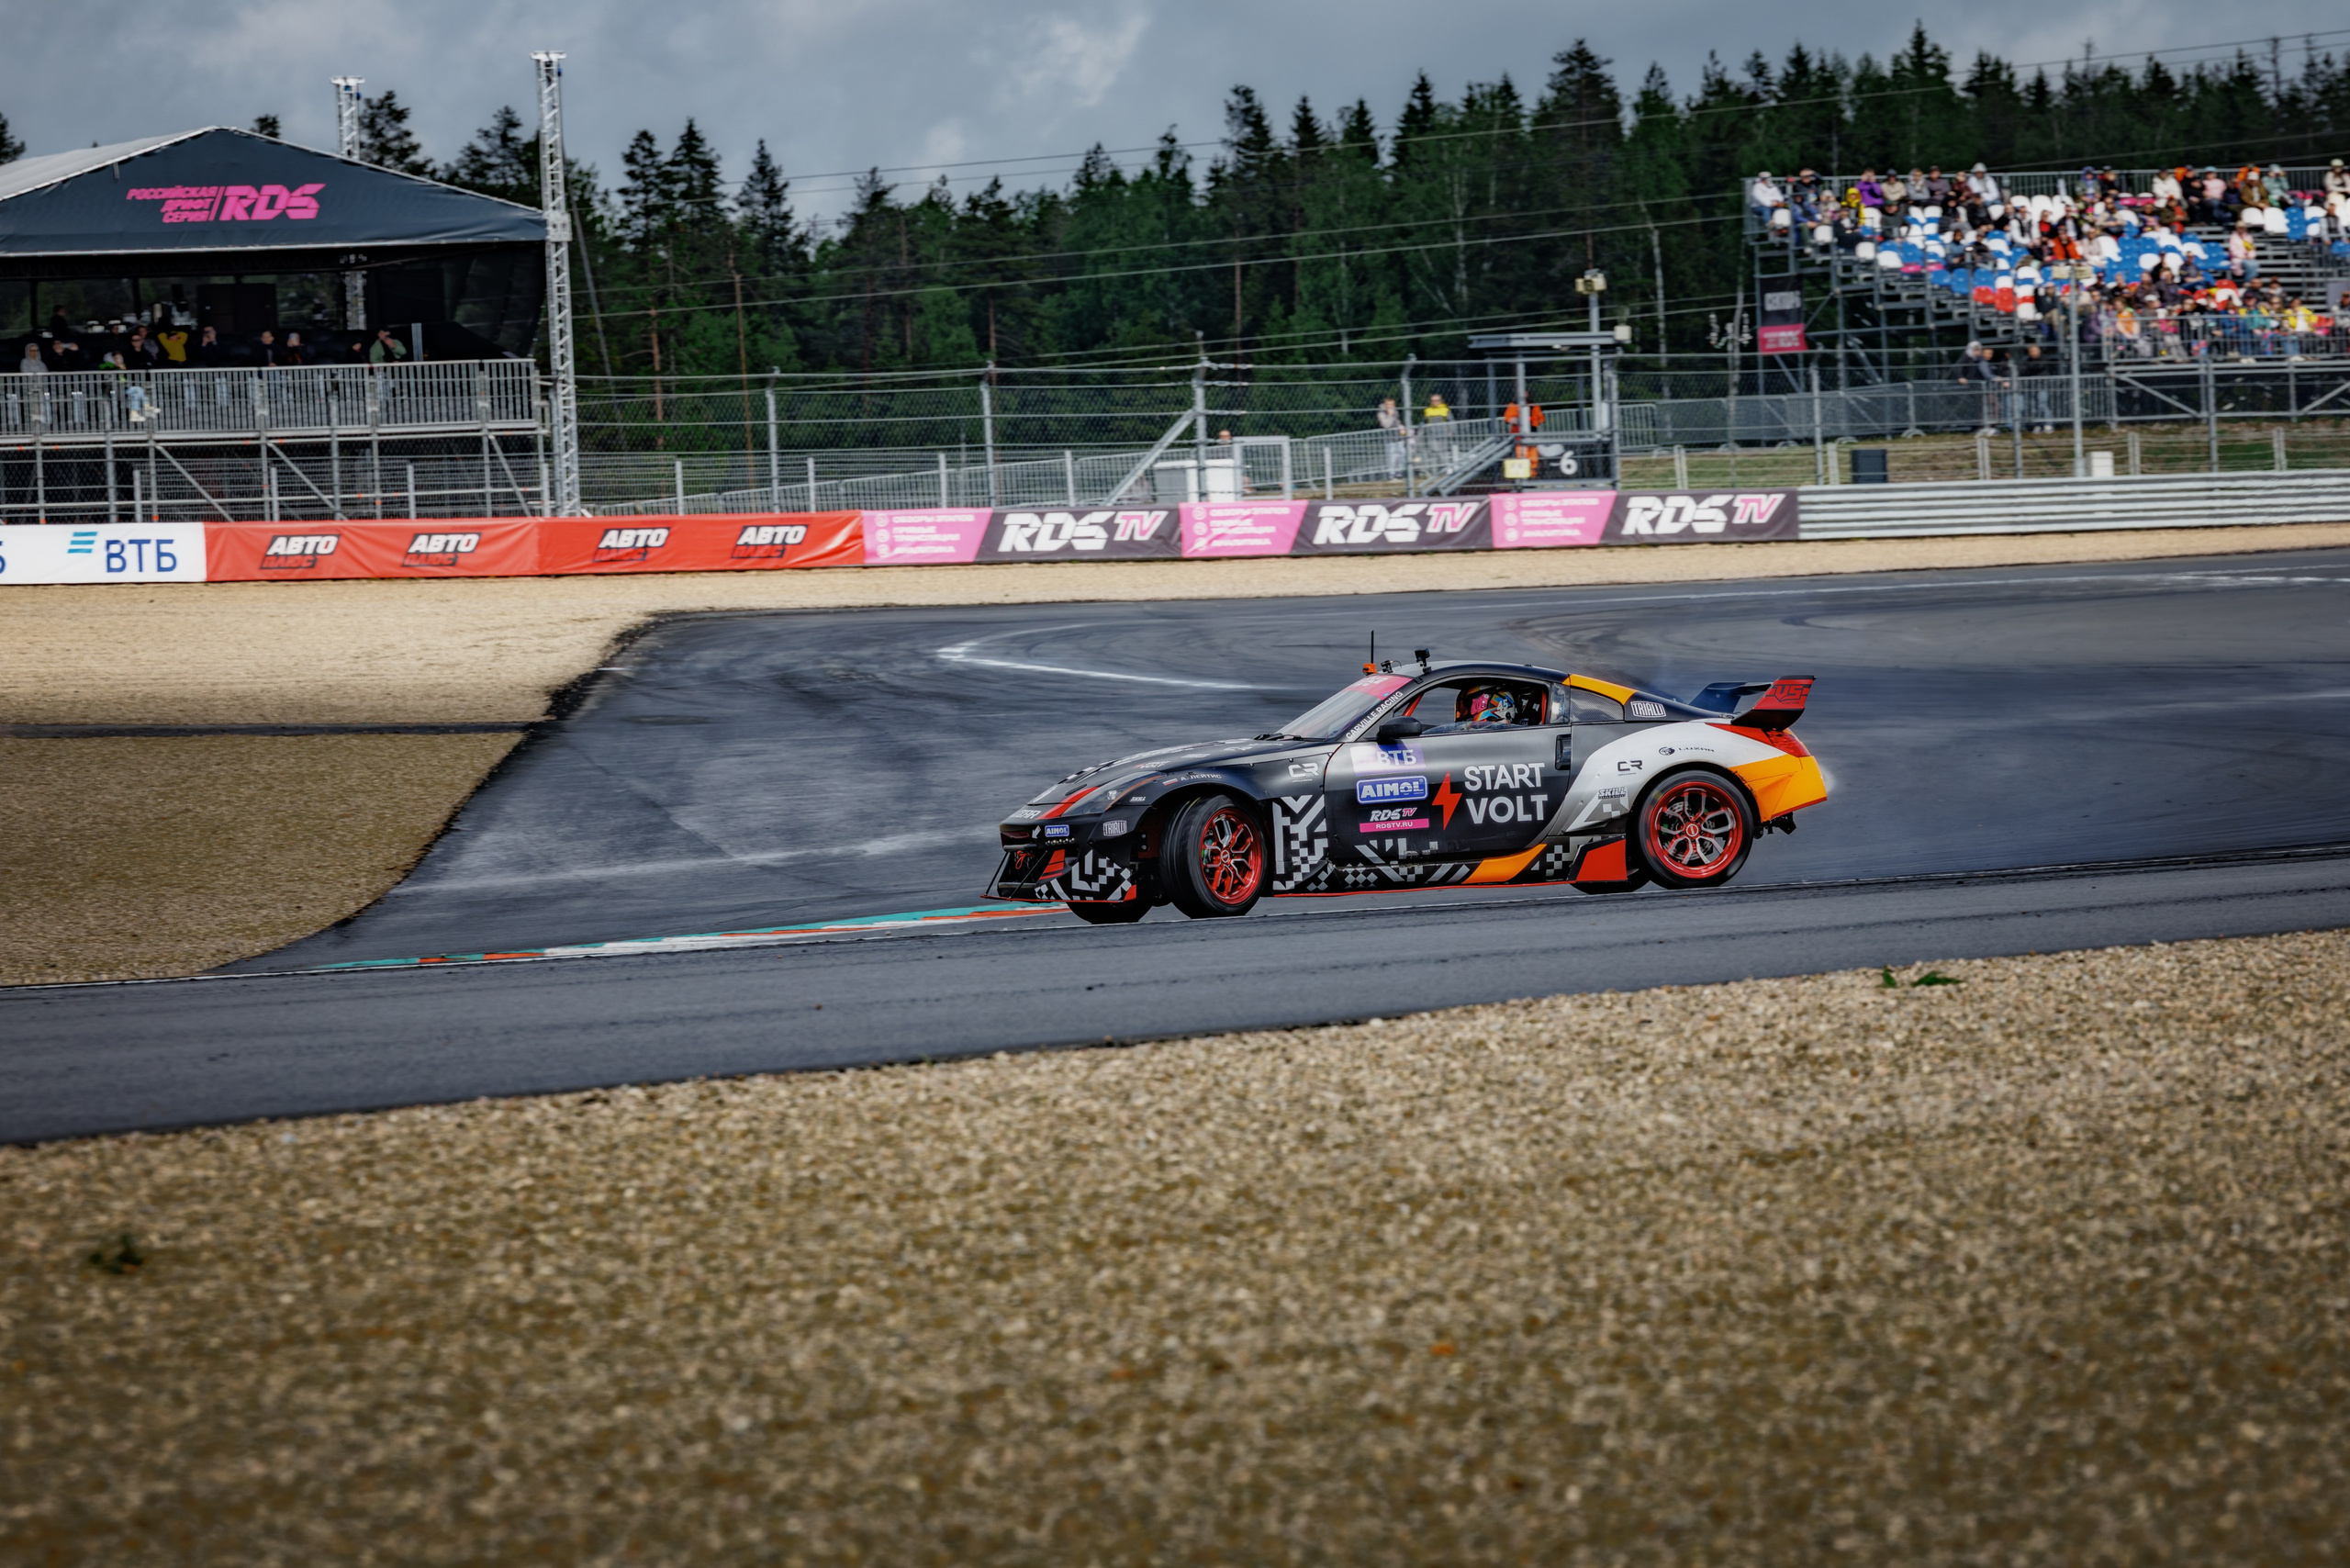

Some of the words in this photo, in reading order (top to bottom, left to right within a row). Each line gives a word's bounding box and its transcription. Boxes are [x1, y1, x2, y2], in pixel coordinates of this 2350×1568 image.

[218, 183, 327, 221] RDS
[1313, 504, 1427, 544] RDS
[1425, 502, 1480, 533] TV
[1621, 495, 1734, 535] RDS
[1732, 494, 1785, 524] TV
[599, 529, 670, 549] АВТО
[736, 525, 808, 545] АВТО
[998, 511, 1115, 552] RDS
[1113, 511, 1169, 541] TV
[266, 535, 340, 555] АВТО
[408, 533, 480, 554] АВТО
[106, 539, 177, 573] ВТБ
[1346, 711, 1378, 739] CARVILLE
[1376, 691, 1404, 714] RACING
[1378, 749, 1416, 767] ВТБ
[1617, 760, 1642, 771] CR
[1289, 763, 1319, 778] CR
[1464, 763, 1545, 790] START
[1360, 781, 1424, 799] AIMOL
[1598, 787, 1626, 797] SKILL
[1370, 809, 1402, 822] RDS
[1402, 808, 1417, 817] TV
[1466, 794, 1548, 824] VOLT
